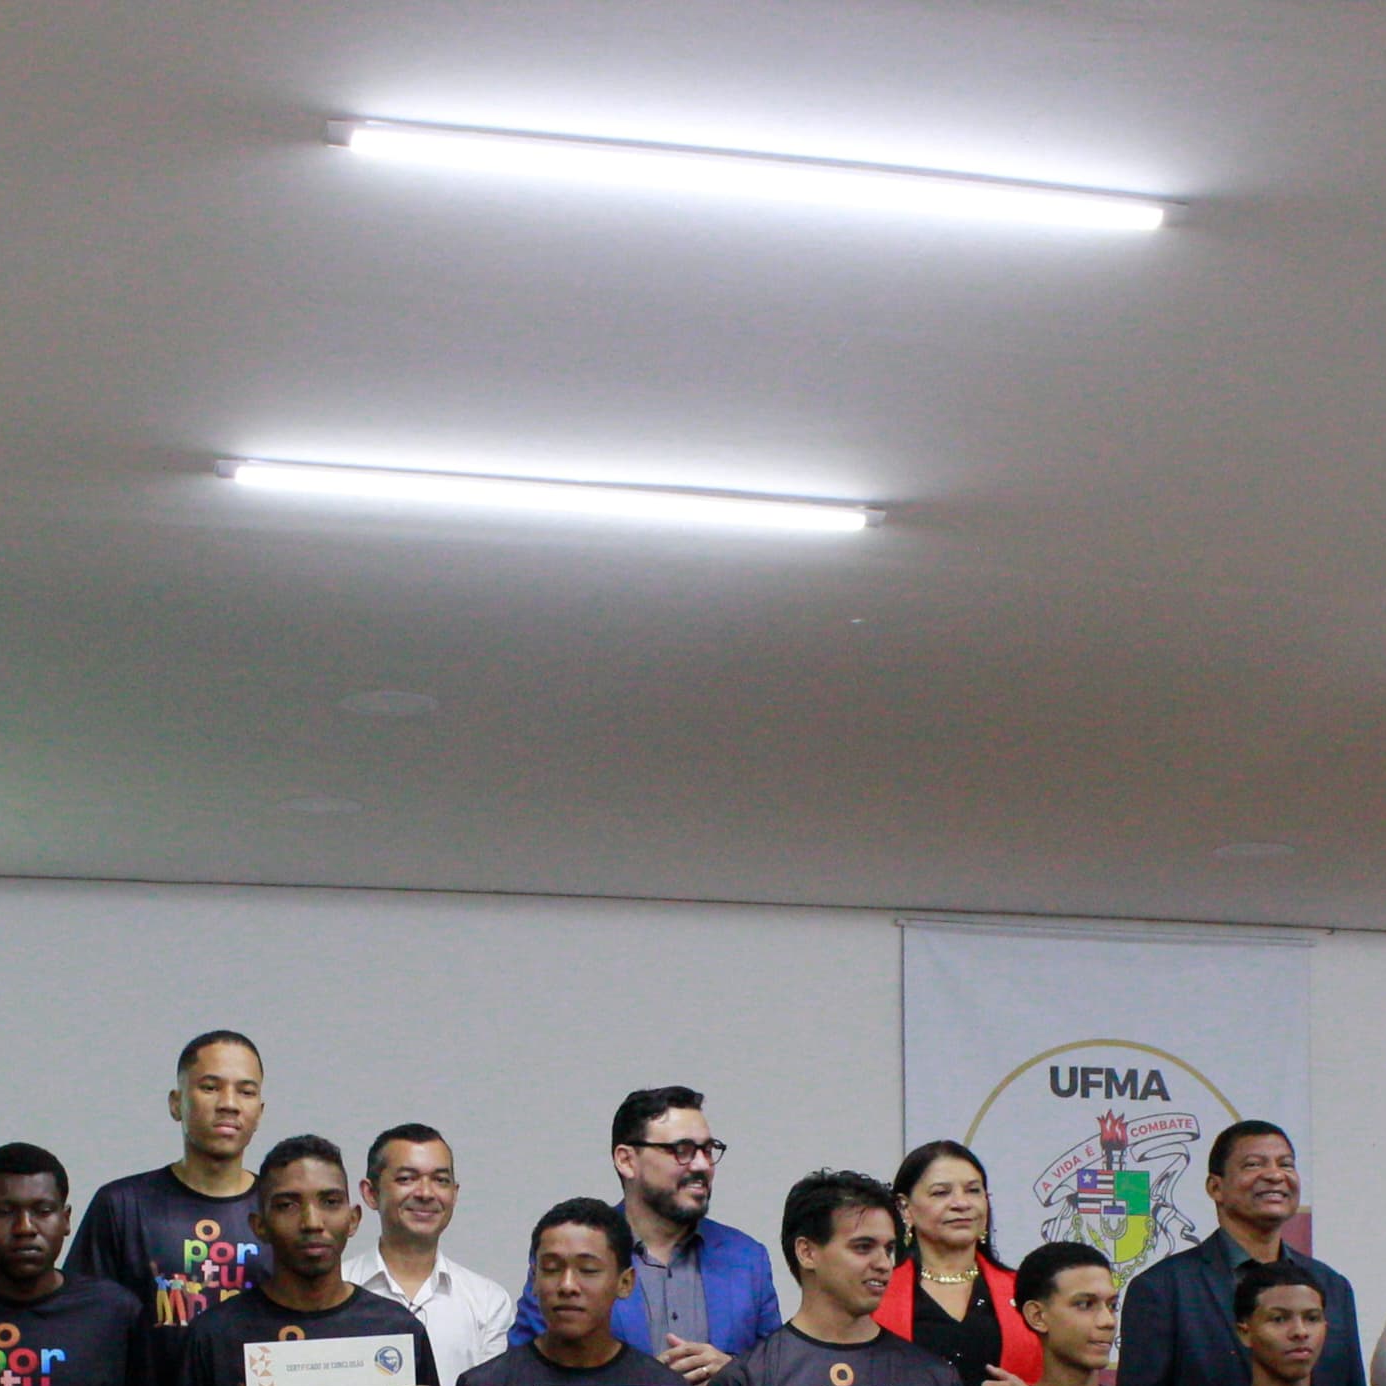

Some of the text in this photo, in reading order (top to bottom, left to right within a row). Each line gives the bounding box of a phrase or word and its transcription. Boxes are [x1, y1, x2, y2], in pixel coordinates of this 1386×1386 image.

[1050, 1066, 1171, 1101] UFMA
[1052, 1155, 1083, 1179] VIDA
[1130, 1118, 1193, 1138] COMBATE
[195, 1219, 221, 1242] o
[184, 1239, 258, 1273] por
[201, 1260, 245, 1289] tu
